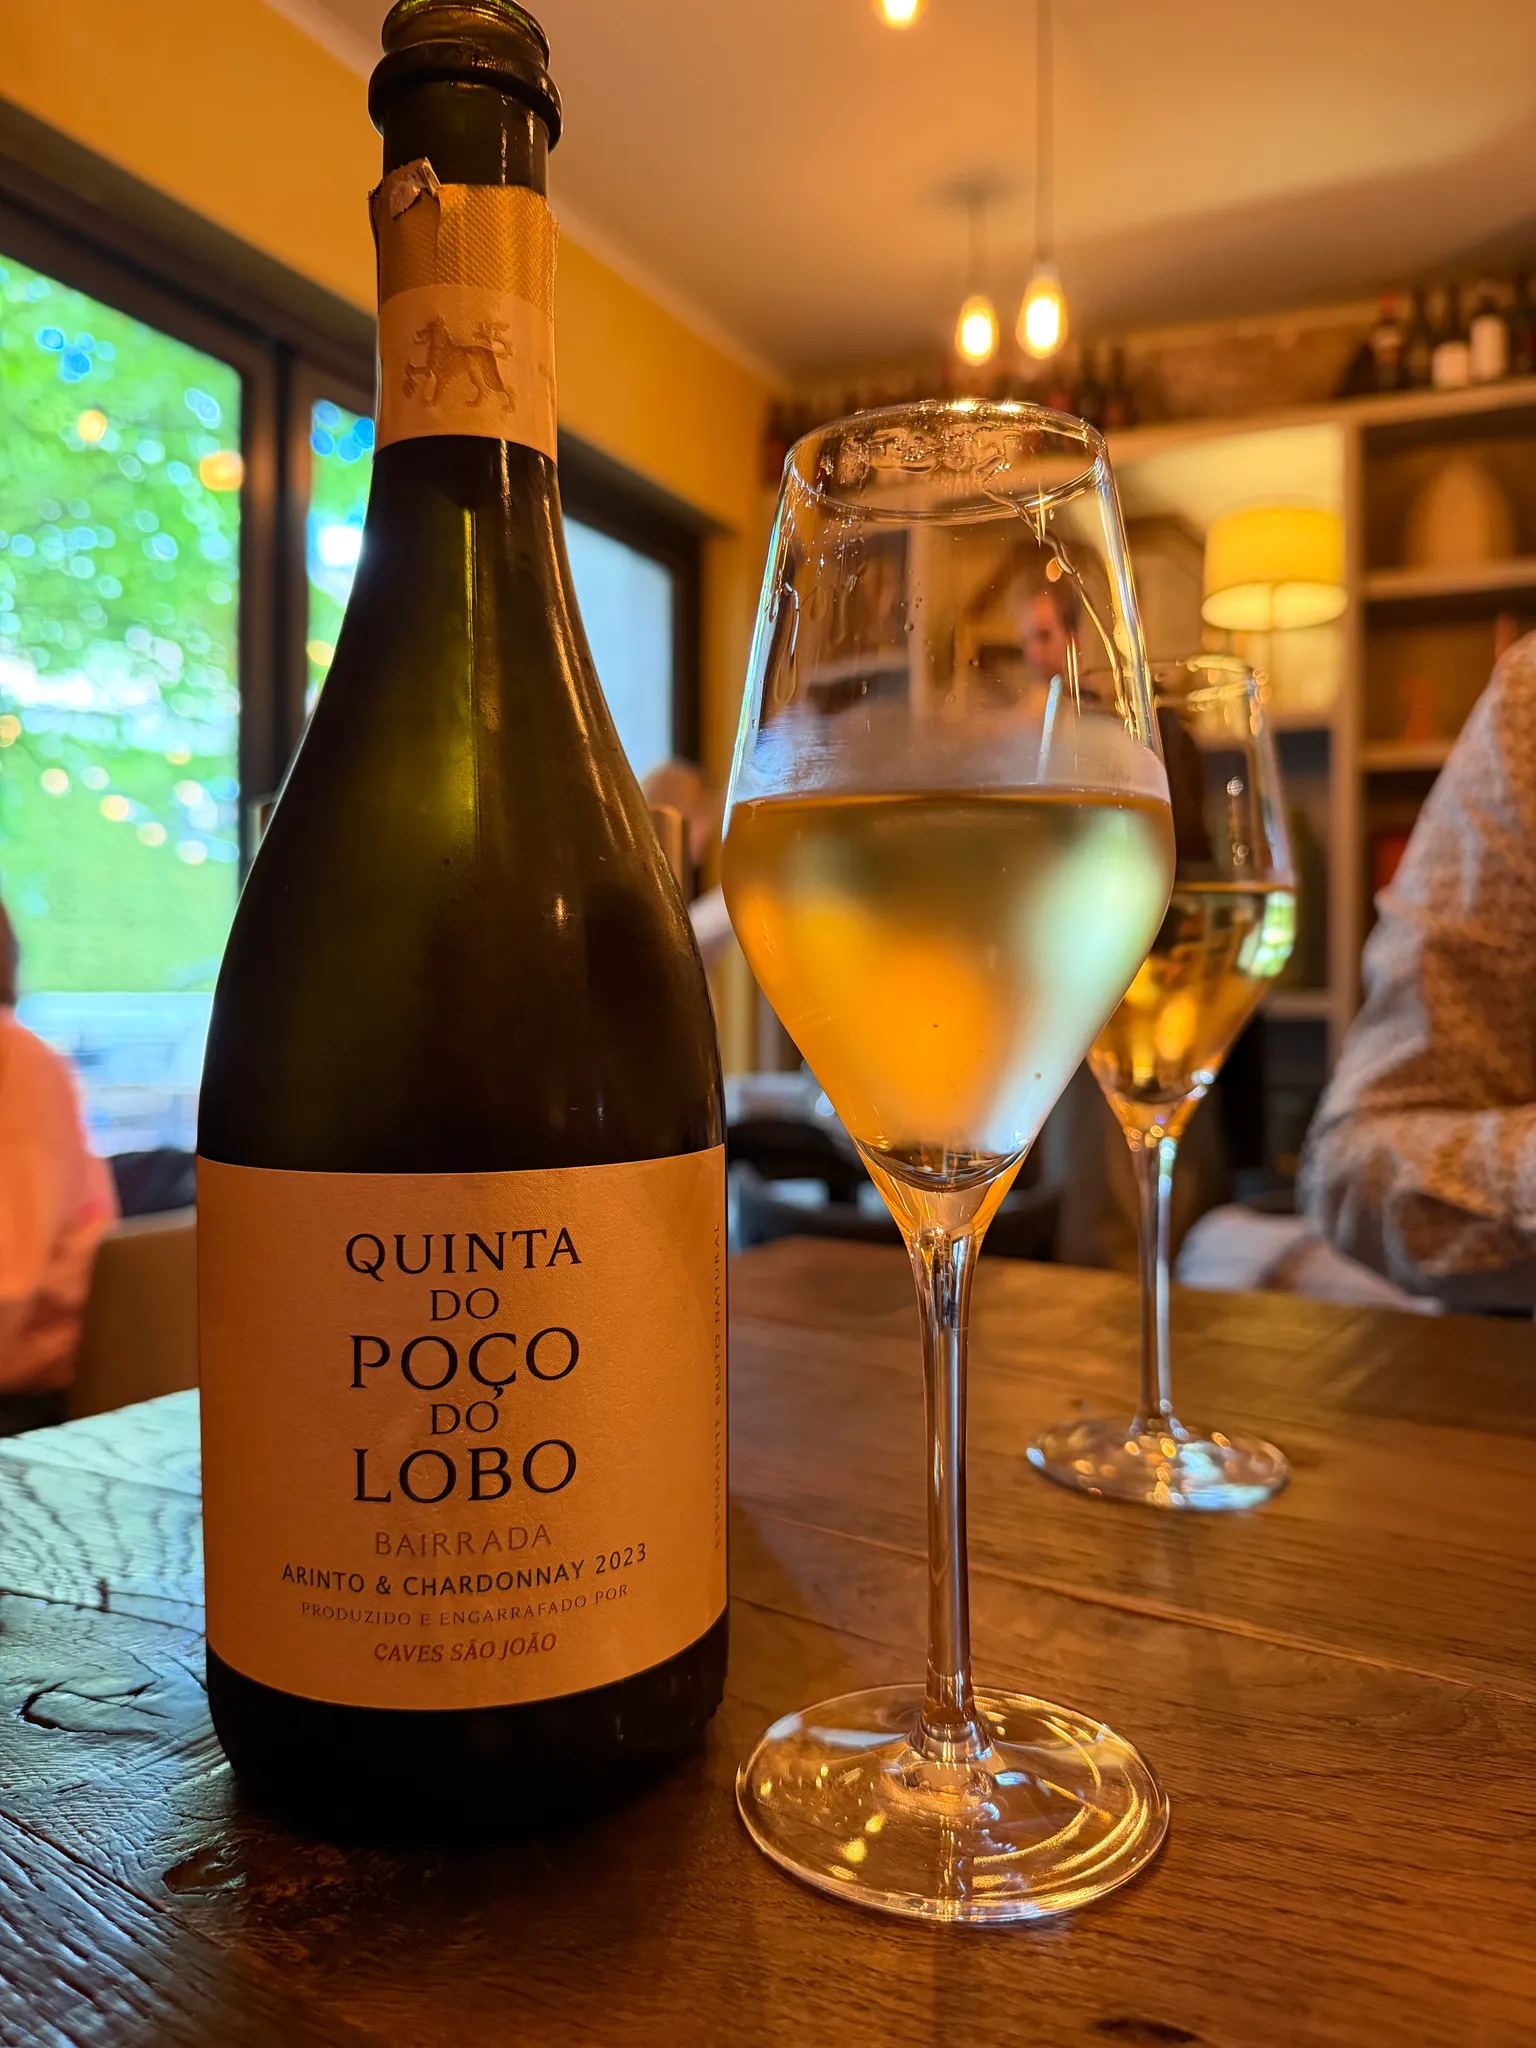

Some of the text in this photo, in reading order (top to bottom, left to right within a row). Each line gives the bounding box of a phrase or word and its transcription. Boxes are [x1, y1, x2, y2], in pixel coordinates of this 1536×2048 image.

[345, 1227, 582, 1281] QUINTA
[713, 1222, 722, 1323] NATURAL
[431, 1288, 499, 1321] DO
[350, 1327, 580, 1400] POÇO
[713, 1334, 722, 1405] BRUTO
[431, 1401, 499, 1435] DO
[354, 1439, 577, 1504] LOBO
[375, 1523, 551, 1557] BAIRRADA
[282, 1542, 647, 1597] ARINTO & CHARDONNAY 2023
[302, 1584, 628, 1627] PRODUZIDO E ENGARRAFADO POR
[374, 1632, 556, 1663] CAVES SÃO JOÃO
